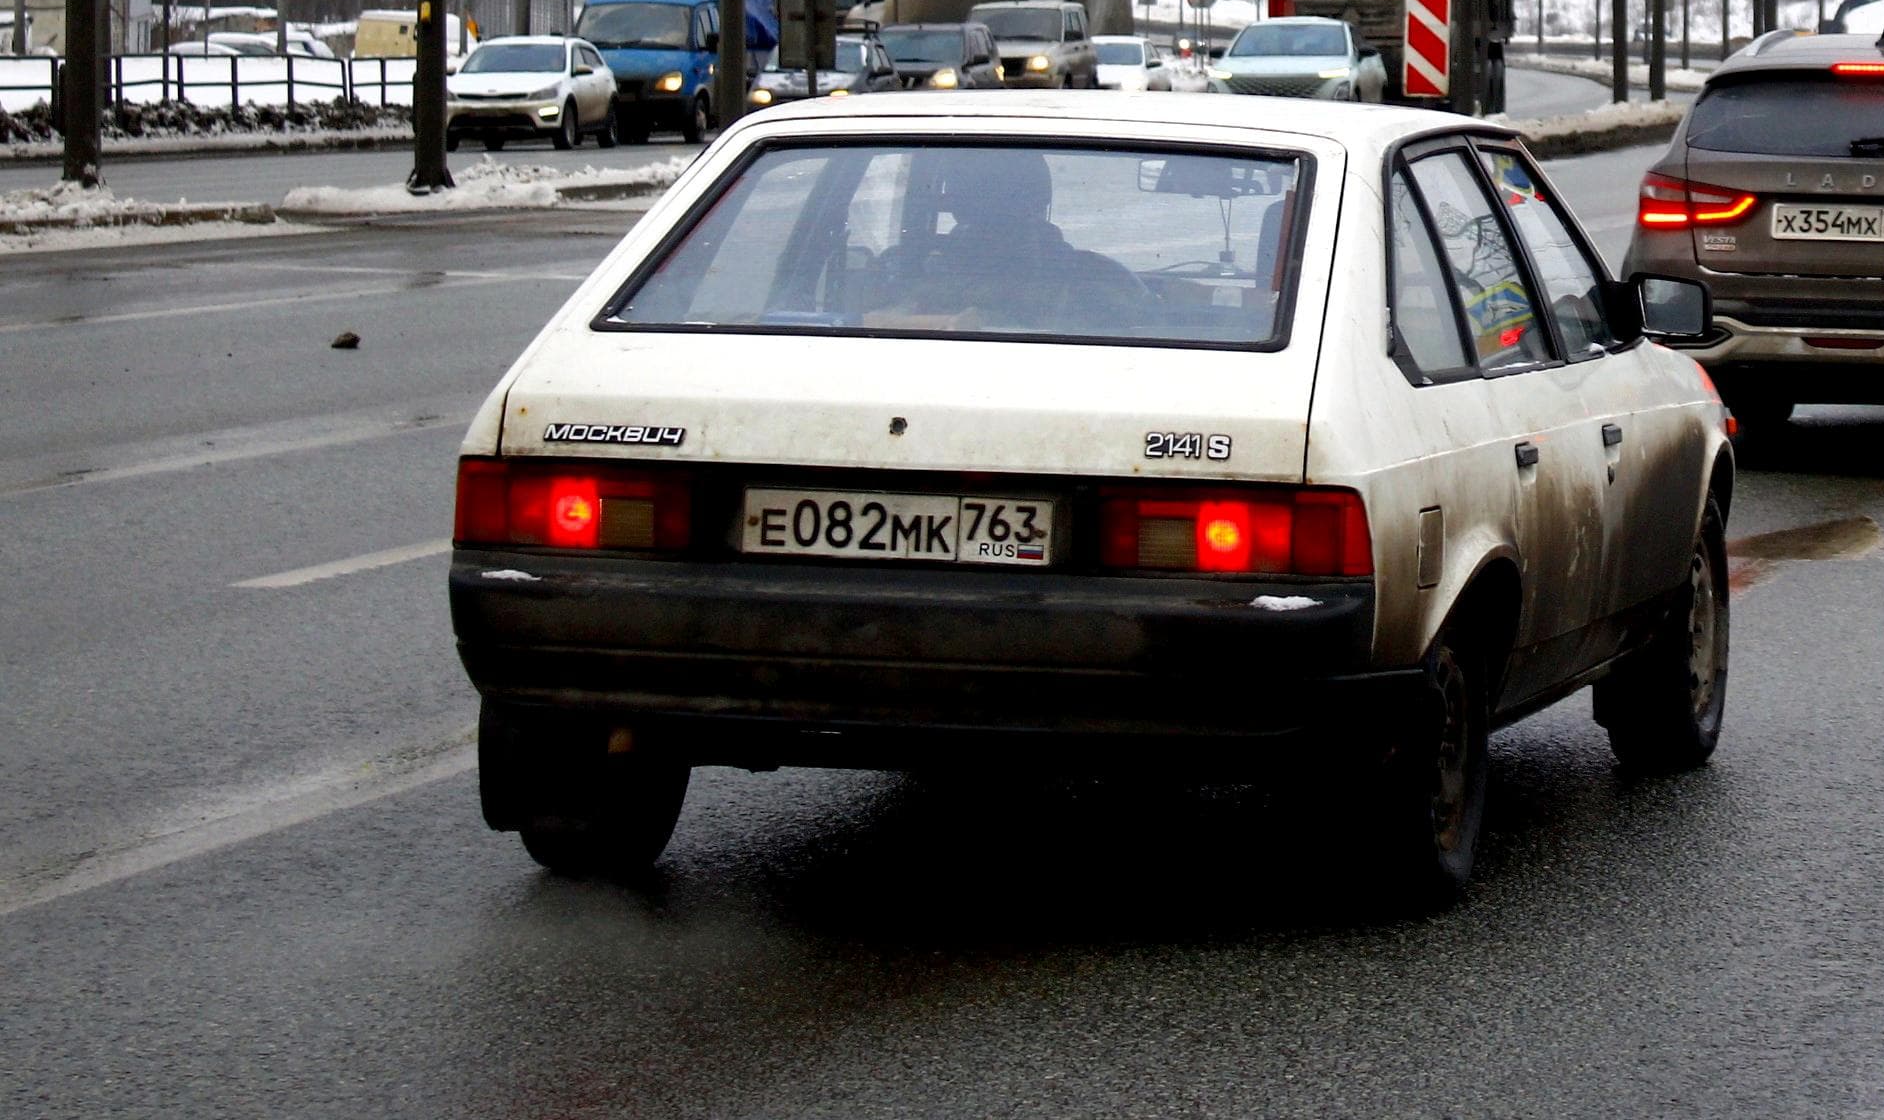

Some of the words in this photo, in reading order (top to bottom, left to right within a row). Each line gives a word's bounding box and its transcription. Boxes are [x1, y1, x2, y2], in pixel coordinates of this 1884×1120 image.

[1145, 432, 1202, 458] 2141
[1208, 435, 1231, 459] S
[965, 503, 1037, 543] 763
[979, 544, 1015, 557] RUS
